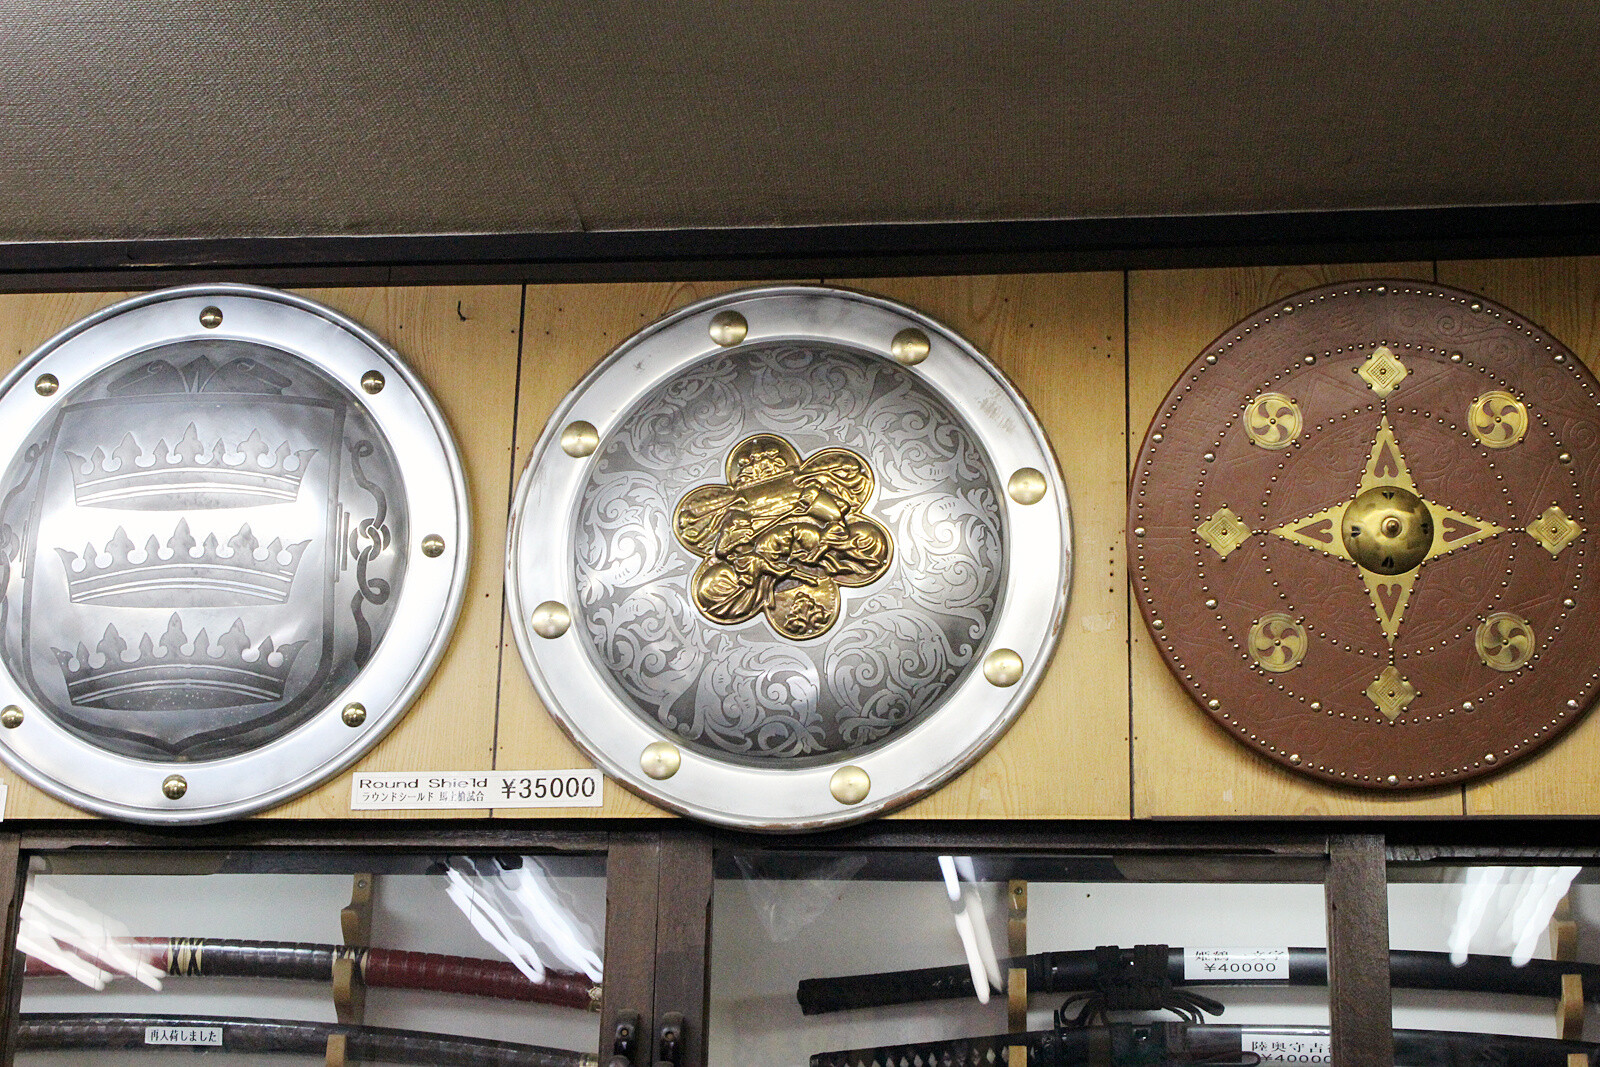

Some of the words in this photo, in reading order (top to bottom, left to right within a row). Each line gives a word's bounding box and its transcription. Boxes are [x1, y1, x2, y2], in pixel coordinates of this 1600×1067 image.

[359, 779, 419, 789] Round
[428, 778, 488, 788] Shield
[501, 777, 595, 798] ¥35000
[361, 791, 434, 802] ラウンドシールド
[1204, 963, 1276, 972] ¥40000
[150, 1029, 217, 1042] 再入荷しました
[1251, 1041, 1331, 1053] 陸奥守吉
